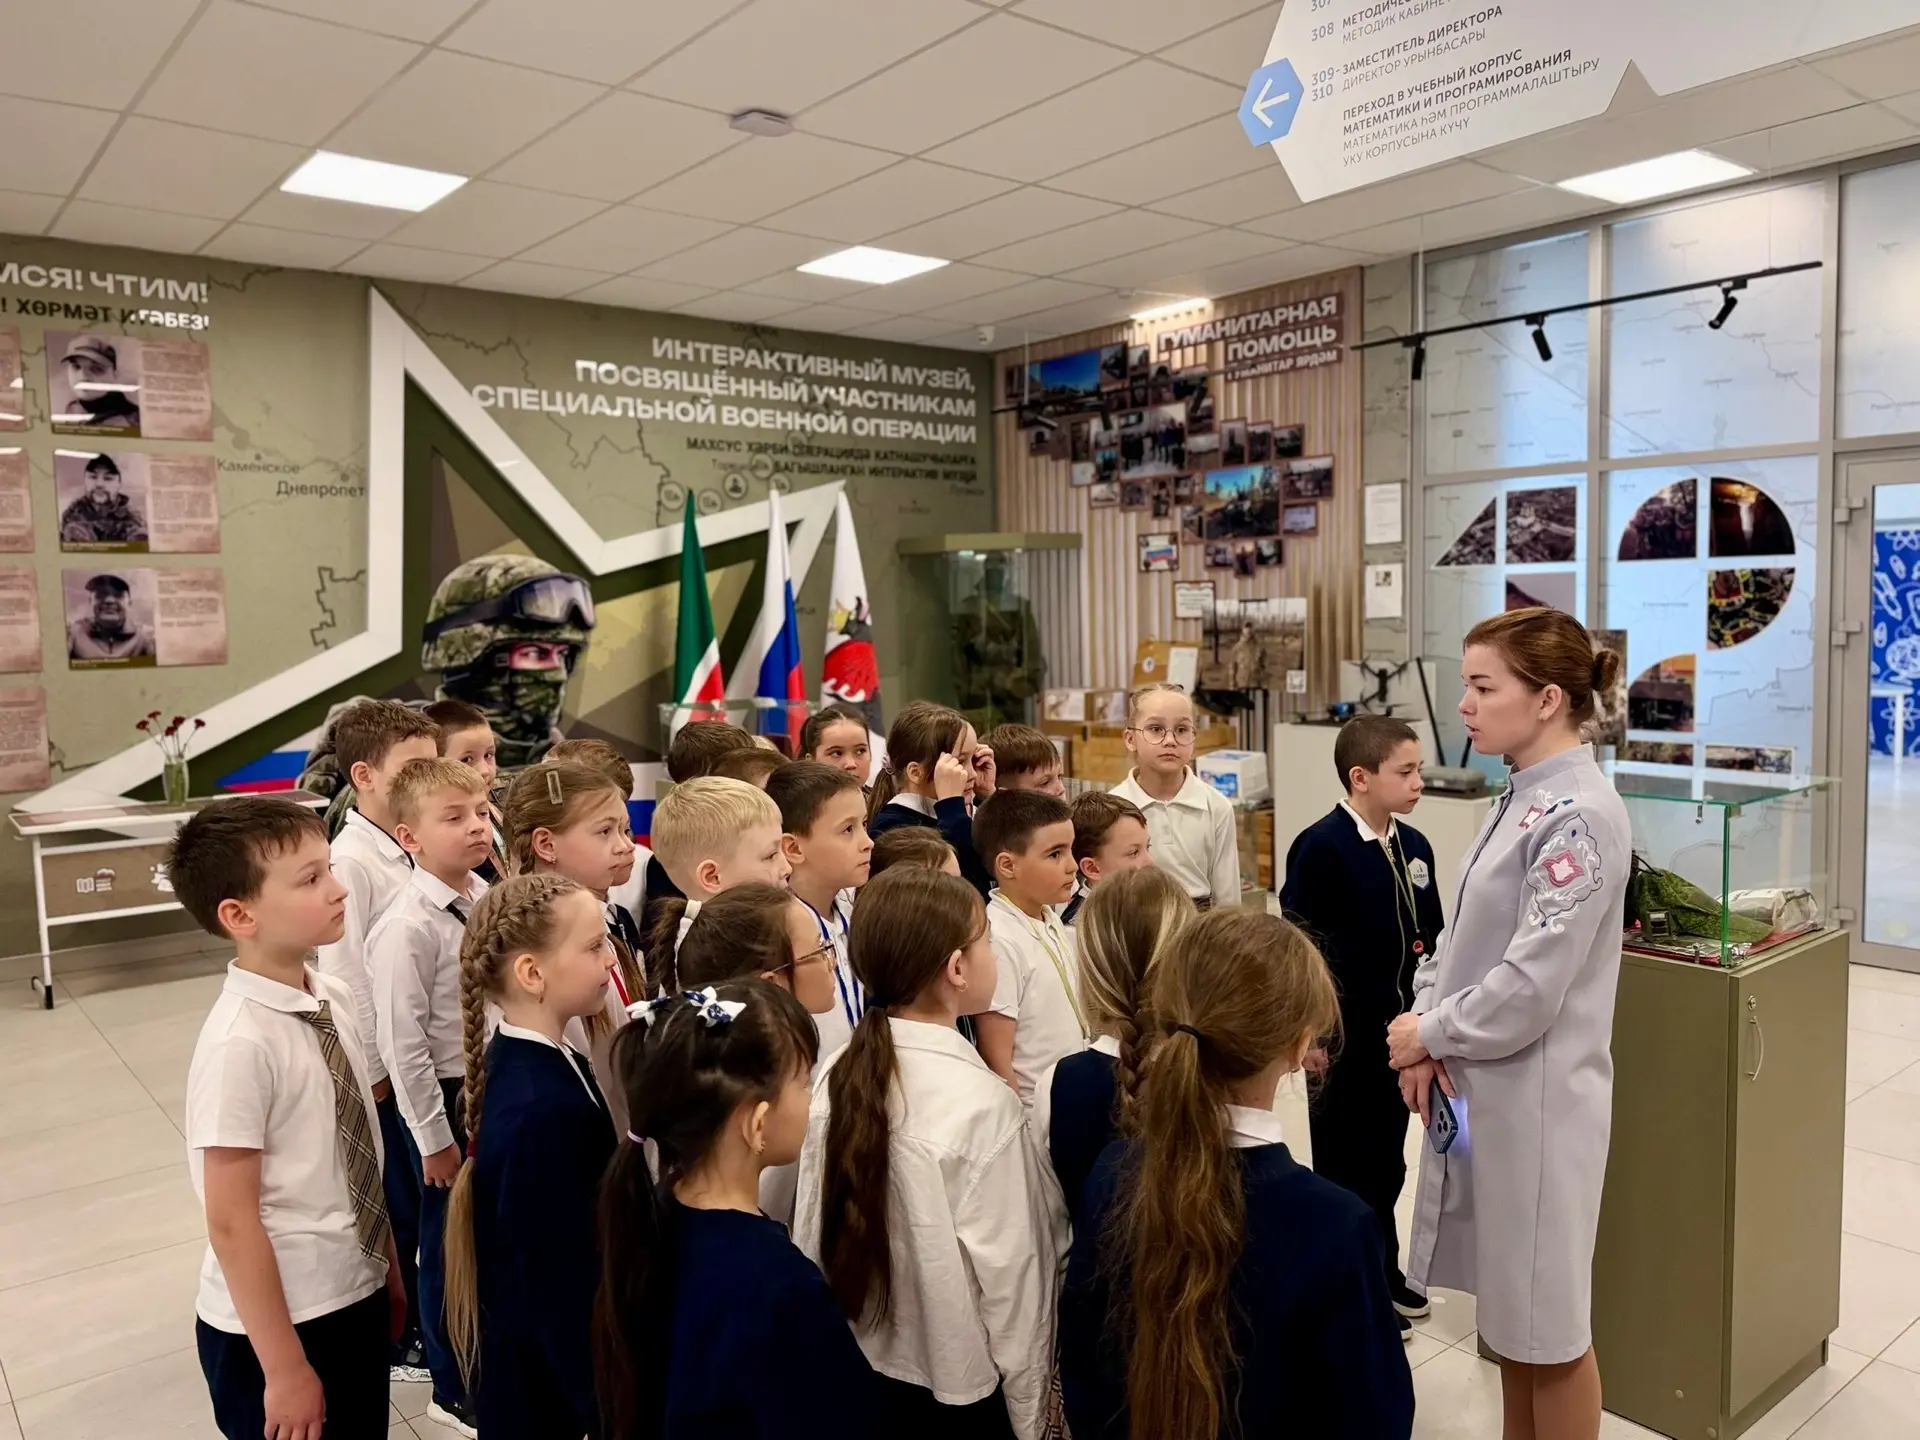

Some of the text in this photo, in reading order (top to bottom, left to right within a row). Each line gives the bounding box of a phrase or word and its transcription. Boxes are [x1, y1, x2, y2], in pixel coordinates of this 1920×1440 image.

[1311, 0, 1411, 41] 308 МЕТОДИЧЕ
[1342, 0, 1450, 44] МЕТОДИК КАБИНЕ
[1342, 36, 1424, 75] ЗАМЕСТИТЕЛЬ
[1427, 5, 1502, 44] ДИРЕКТОРА
[1311, 28, 1486, 101] 310 ДИРЕКТОР УРЫНБАСАРЫ
[1343, 49, 1522, 120] ПЕРЕХОД В УЧЕБНЫЙ КОРПУС
[1343, 49, 1571, 135] МАТЕМАТИКИ И ПРОГРАМИРОВАНИЯ
[1343, 118, 1418, 151] МАТЕМАТИКА
[1450, 57, 1600, 116] ПРОГРАММАЛАШТЫРУ
[1343, 152, 1363, 167] УКУ
[1365, 128, 1437, 160] КОРПУСЫНА
[16, 298, 111, 322] ХӨРМӘТ
[89, 271, 208, 303] ЧТИМ!
[1159, 296, 1337, 351] ГУМАНИТАРНАЯ
[1227, 325, 1337, 361] ПОМОЩЬ
[575, 360, 976, 417] ПОСВЯЩЁННЫЙ УЧАСТНИКАМ
[652, 337, 976, 393] ИНТЕРАКТИВНЫЙ МУЗЕЙ,
[471, 384, 976, 444] СПЕЦИАЛЬНОЙ ВОЕННОЙ ОПЕРАЦИИ
[217, 458, 300, 474] Каменское
[686, 437, 742, 452] МАХСУС
